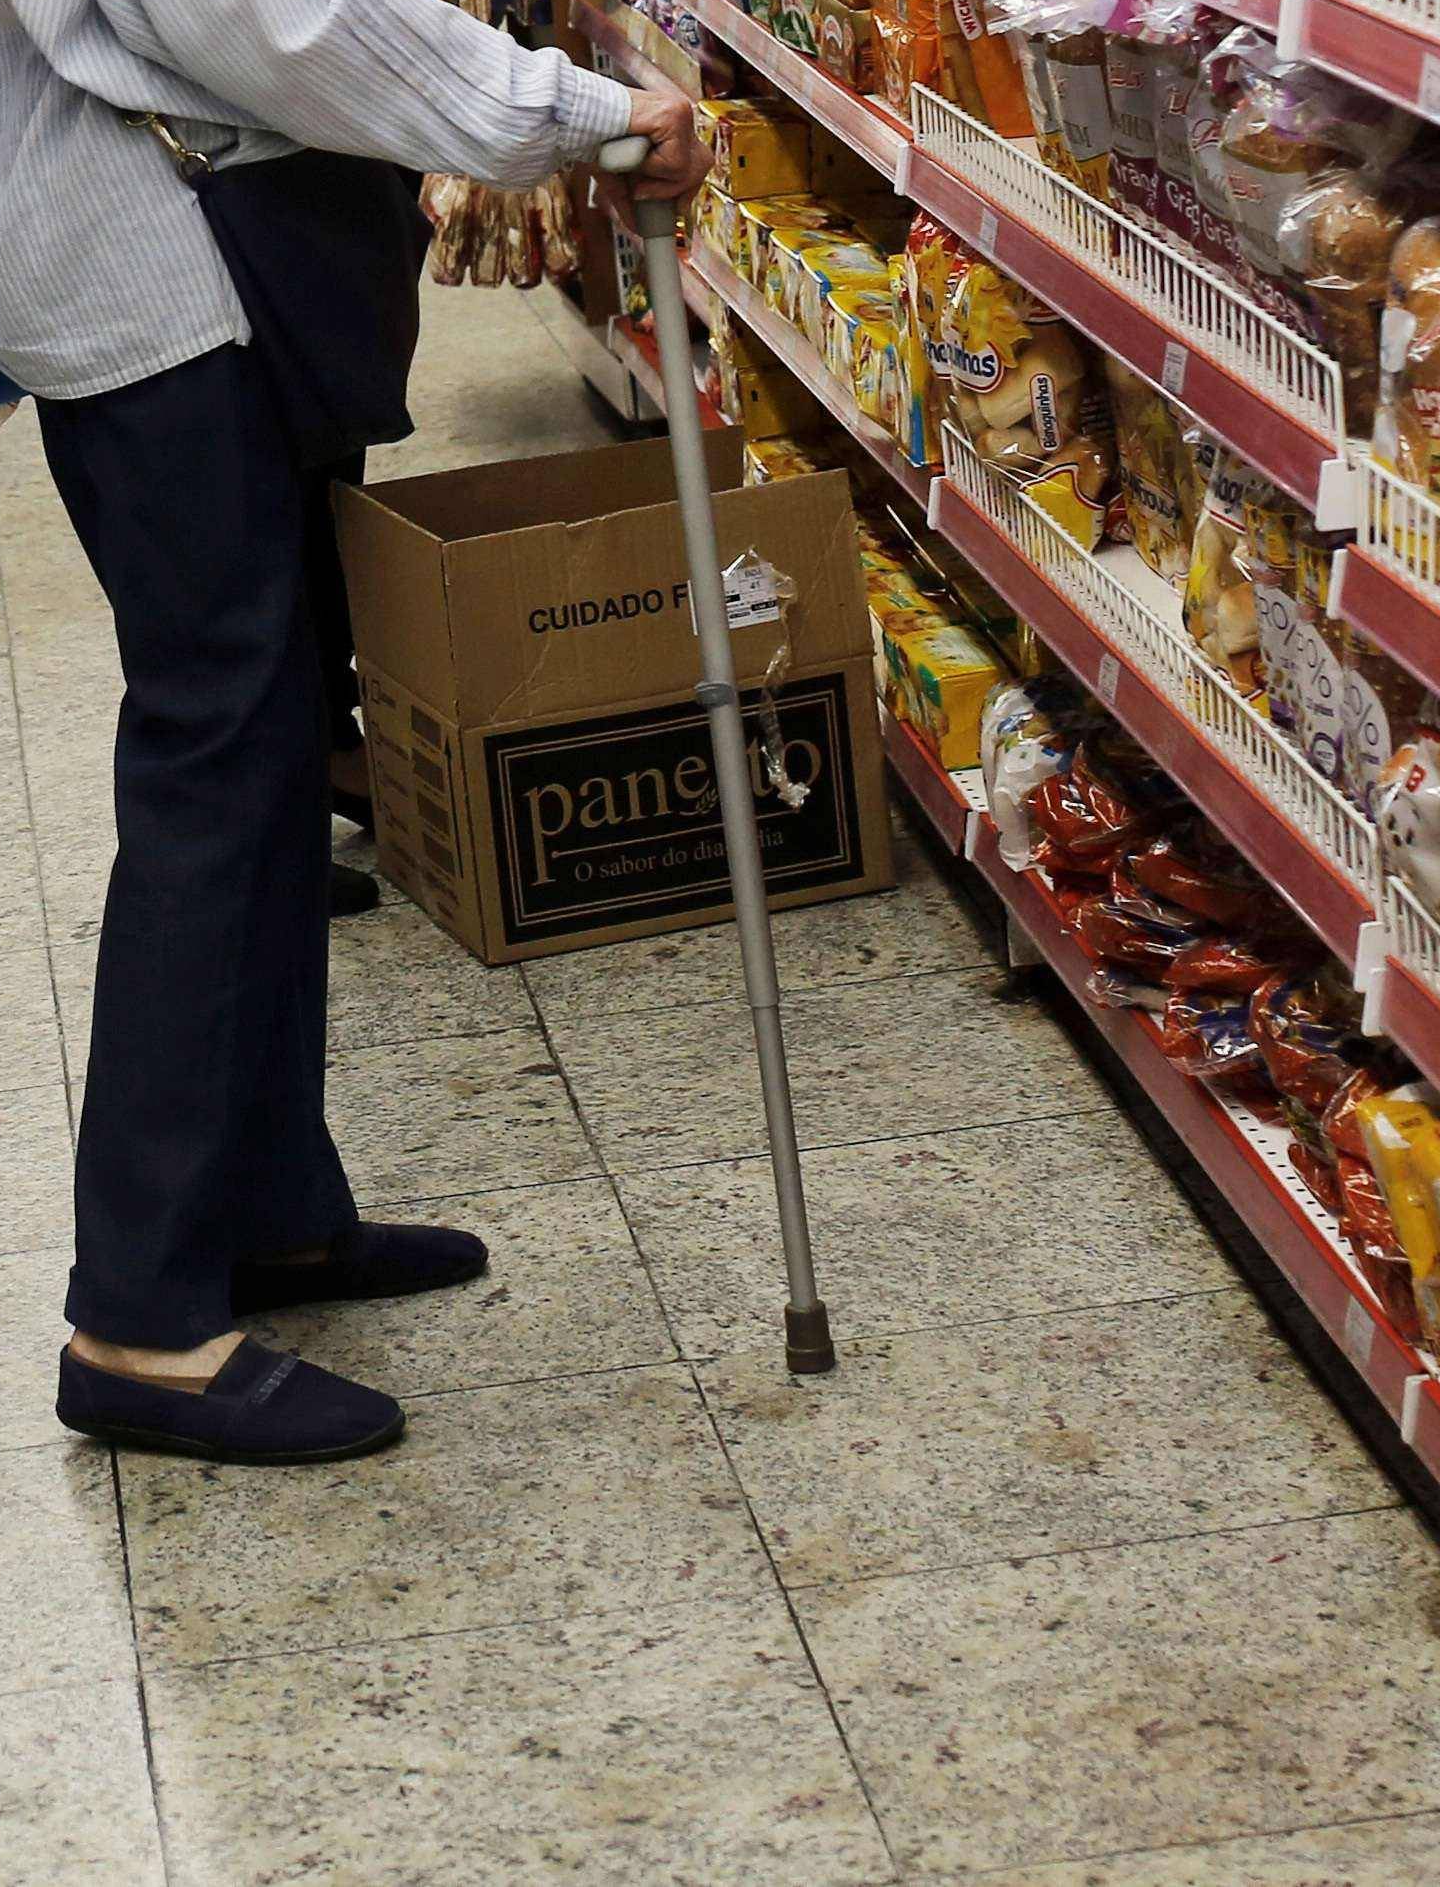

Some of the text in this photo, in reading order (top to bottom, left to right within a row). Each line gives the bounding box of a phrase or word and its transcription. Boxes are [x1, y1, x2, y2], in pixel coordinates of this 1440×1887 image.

[527, 588, 665, 635] CUIDADO
[672, 583, 691, 611] F
[523, 736, 822, 889] paneto
[574, 858, 593, 883] O
[599, 851, 655, 877] sabor
[661, 846, 689, 867] do
